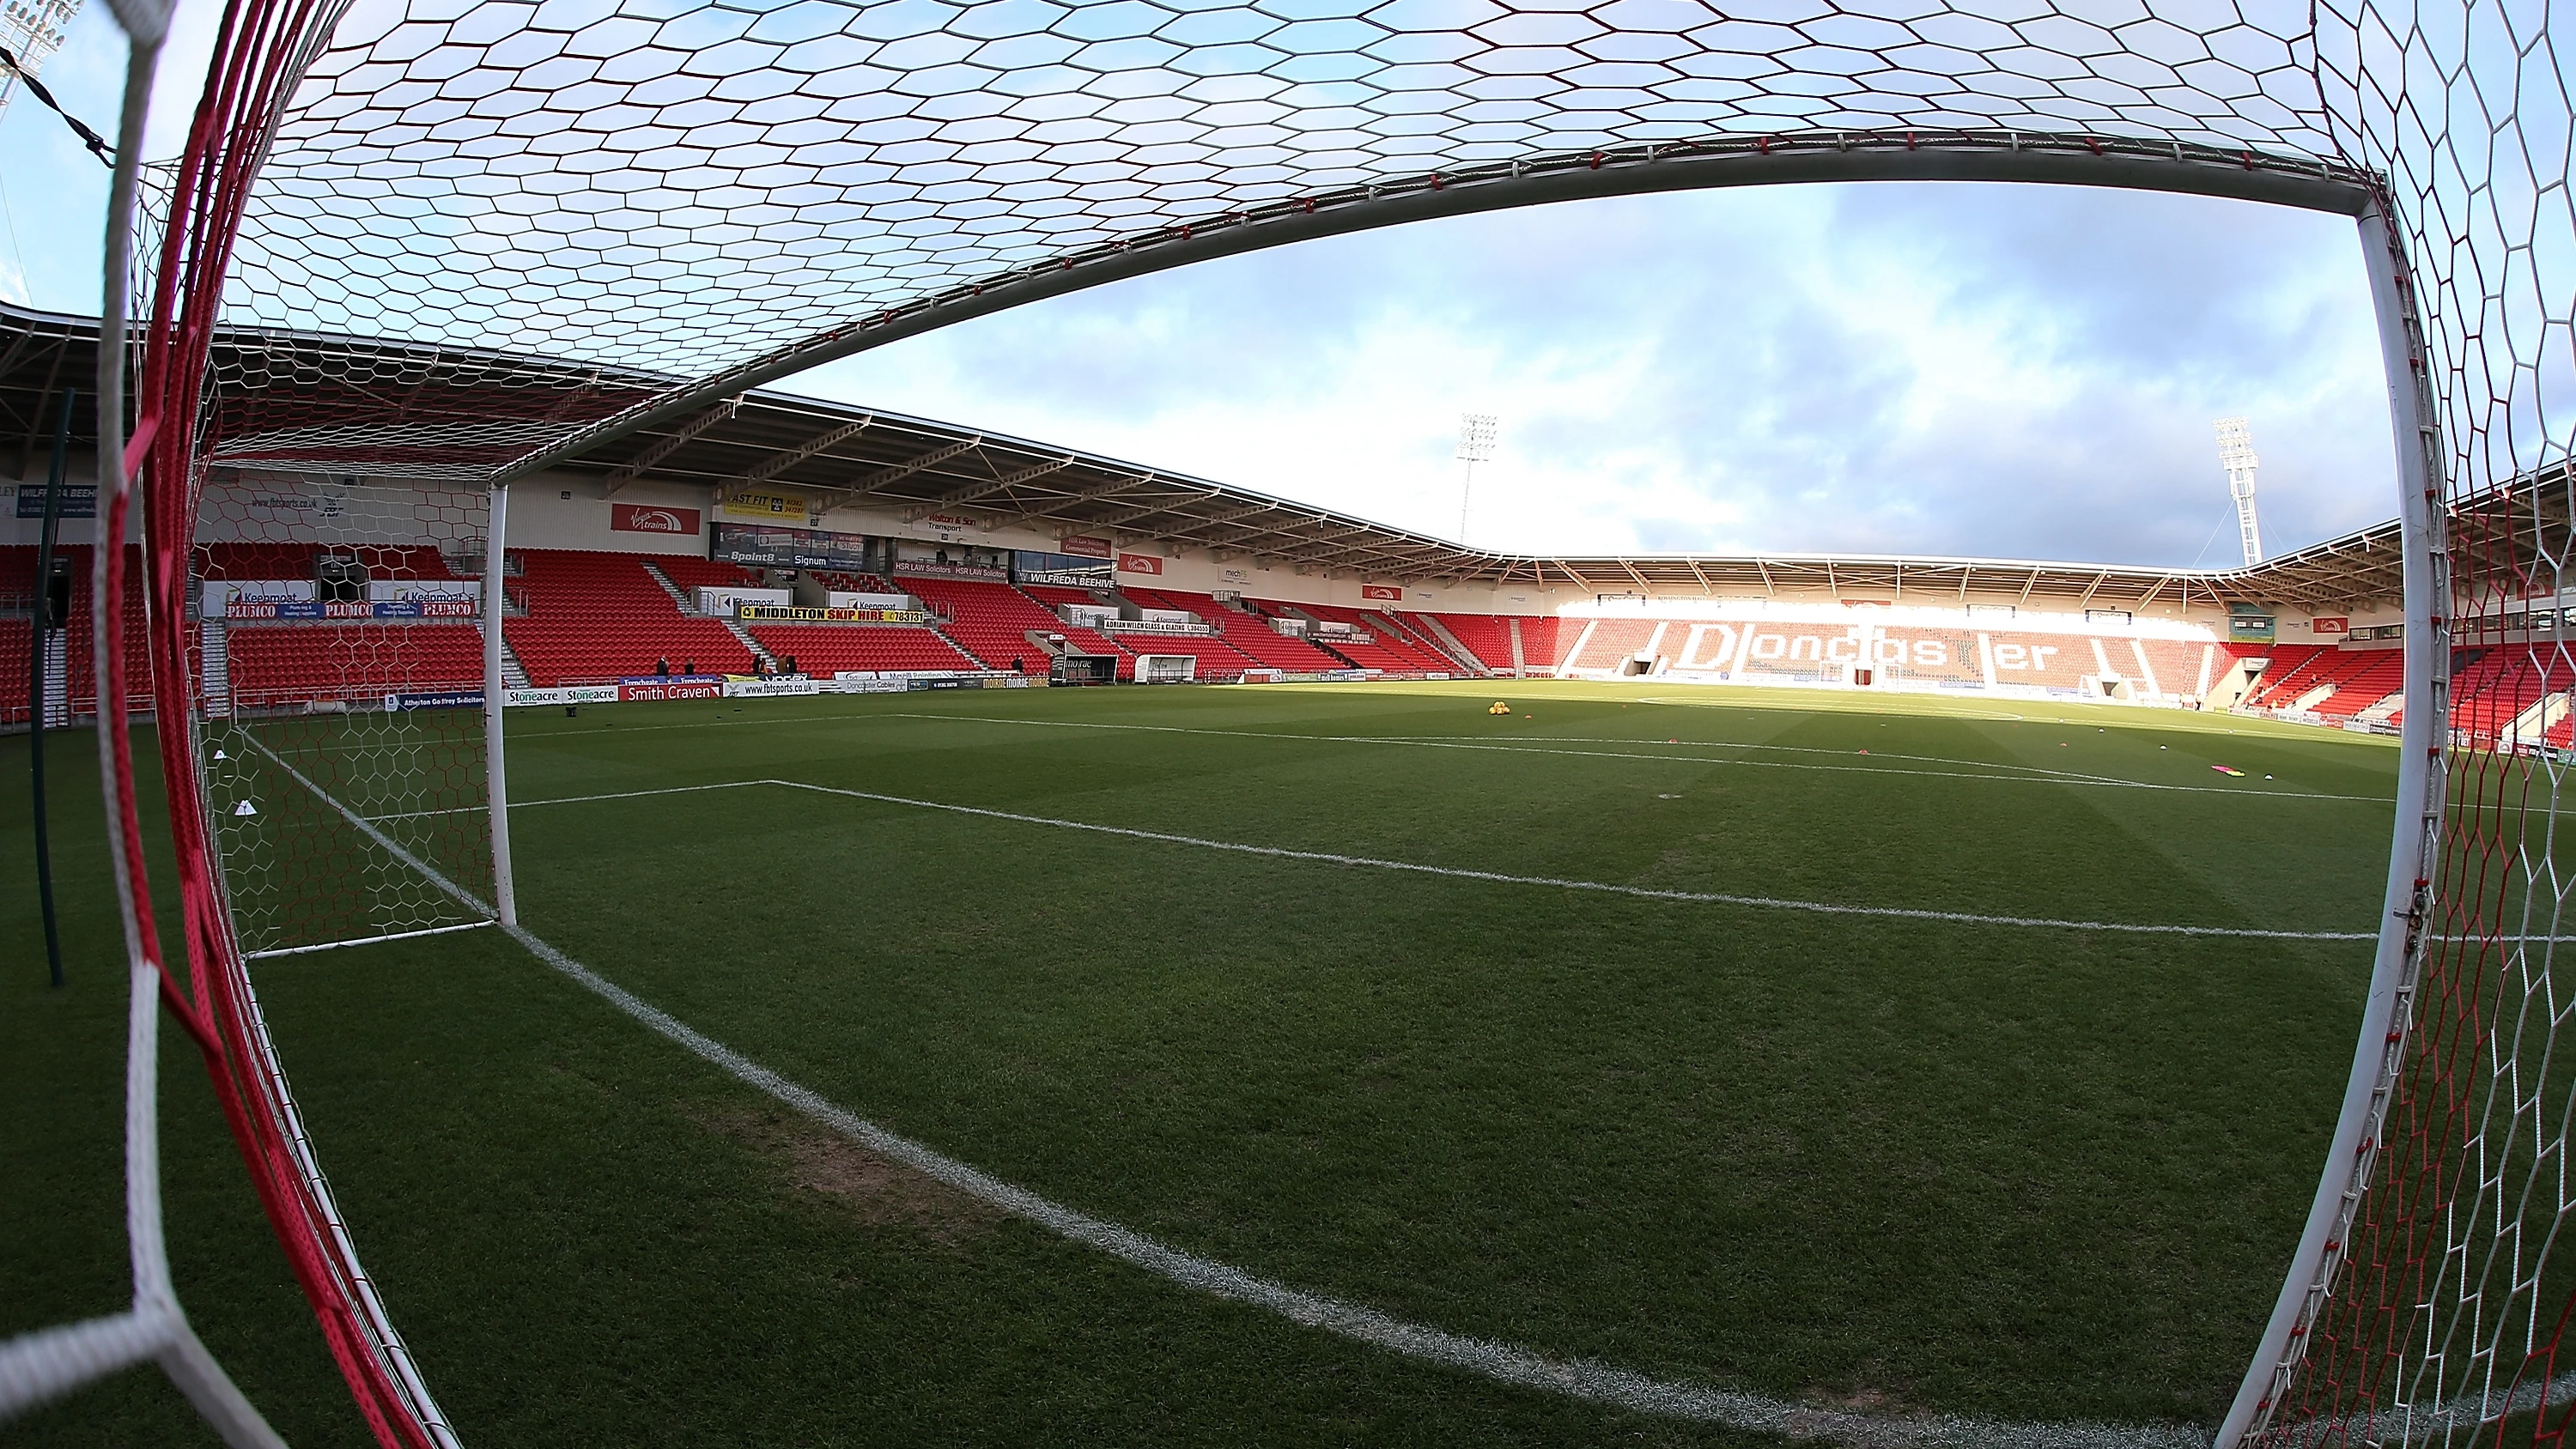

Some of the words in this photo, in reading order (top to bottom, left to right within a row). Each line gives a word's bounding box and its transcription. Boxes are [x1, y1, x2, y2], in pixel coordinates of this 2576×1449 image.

[728, 494, 751, 504] AST
[753, 494, 769, 506] FIT
[630, 507, 652, 530] Virgin
[928, 513, 953, 524] Walton
[956, 516, 962, 524] &
[963, 517, 976, 526] Son
[644, 521, 667, 530] trains
[928, 522, 962, 532] Transport
[731, 551, 775, 562] 8point8
[794, 555, 826, 566] Signum
[896, 562, 910, 571] HSR
[926, 565, 951, 573] Solicitors
[982, 569, 1006, 578] Solicitors
[1030, 573, 1077, 585] WILFREDA
[1078, 578, 1115, 588] BEEHIVE
[228, 604, 276, 617] PLUMCO
[326, 603, 374, 616] PLUMCO
[423, 603, 471, 615] PLUMCO
[755, 607, 824, 619] MIDDLETON
[827, 609, 856, 620] SKIP
[857, 610, 884, 621] HIRE
[895, 611, 923, 621] 783731
[744, 682, 812, 694] www.fbtsports.co.uk
[1006, 677, 1029, 688] MOIRAE
[509, 690, 558, 702] Stoneacre
[567, 689, 614, 700] Stoneacre
[628, 686, 665, 700] Smith
[668, 685, 710, 699] Craven
[457, 695, 484, 704] Solicitors
